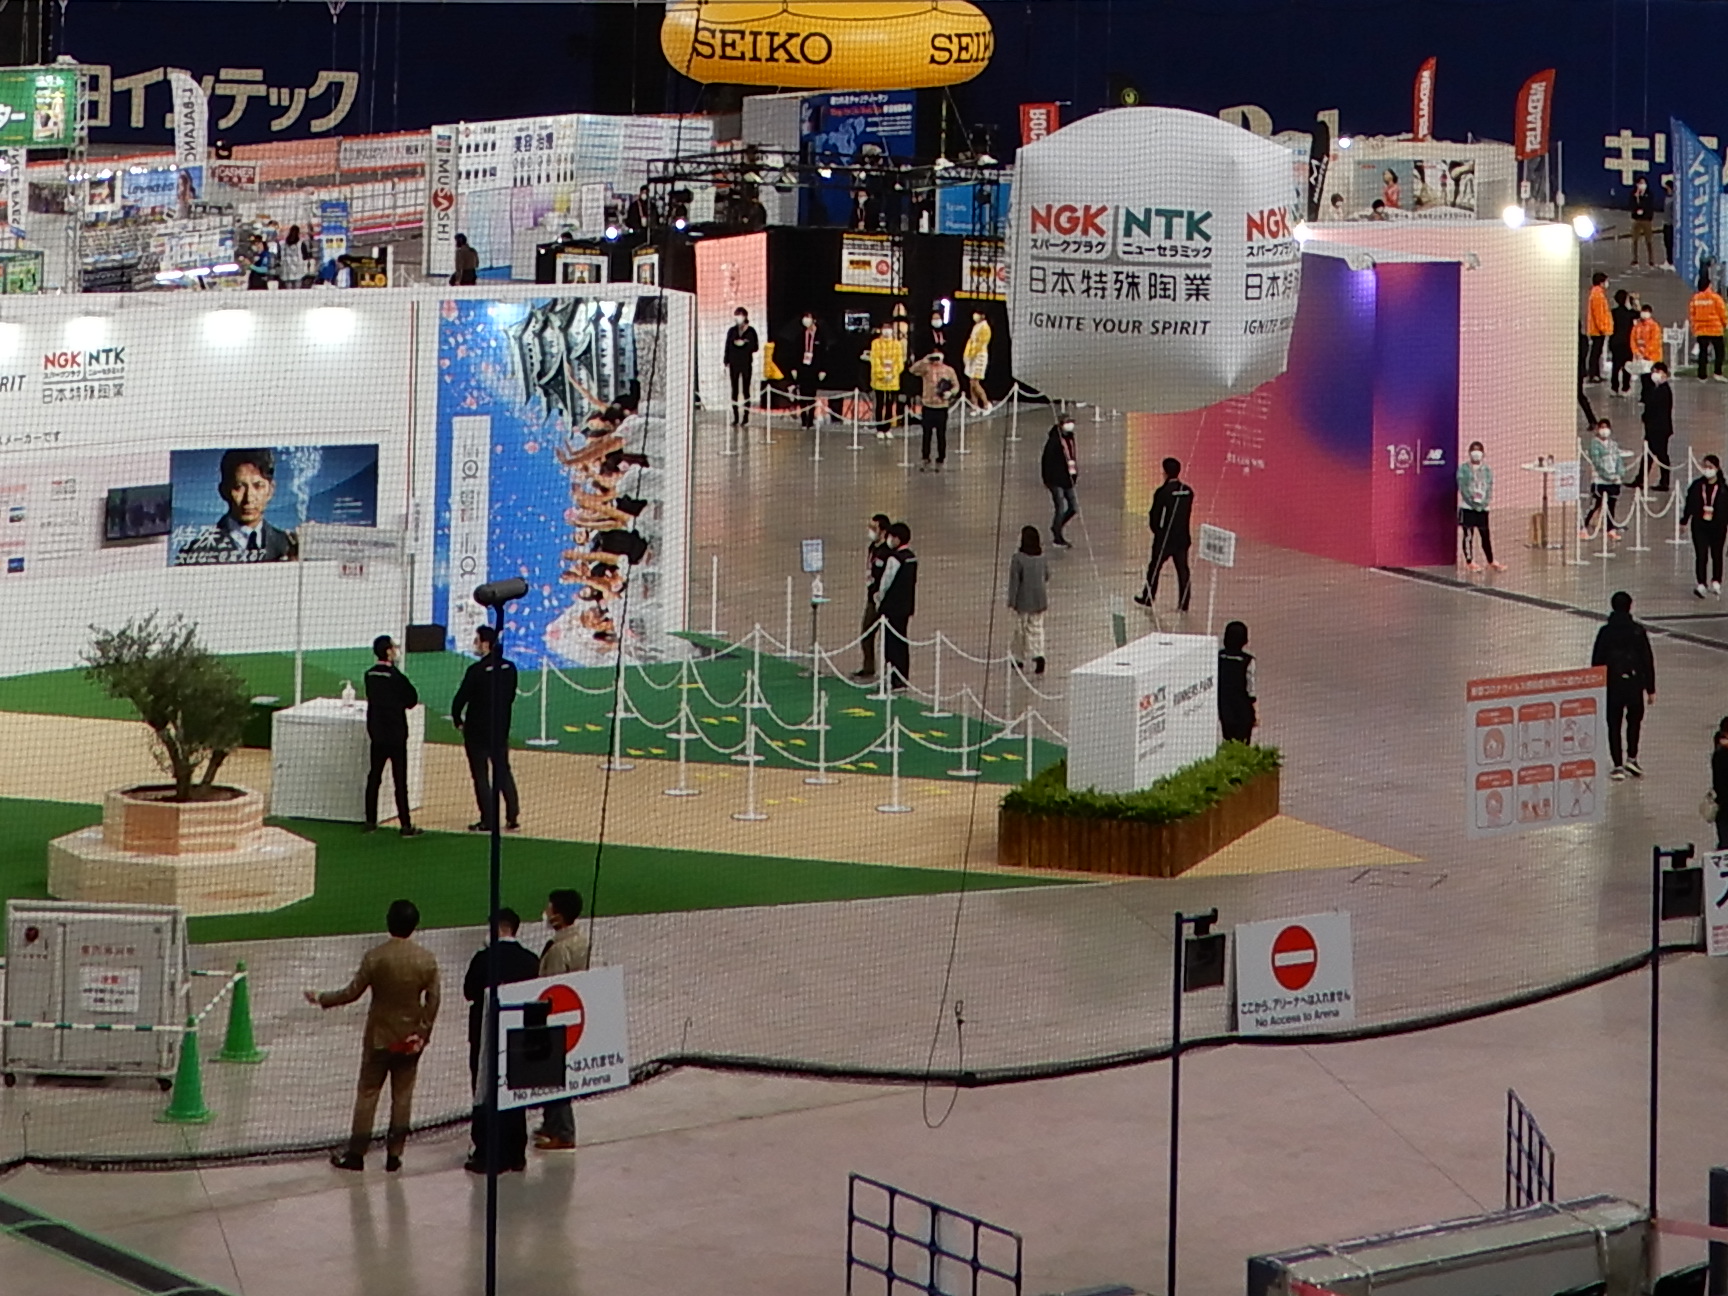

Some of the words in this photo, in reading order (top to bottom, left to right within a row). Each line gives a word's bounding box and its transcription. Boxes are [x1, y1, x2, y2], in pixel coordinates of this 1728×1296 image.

[693, 27, 833, 65] SEIKO
[433, 158, 455, 244] MUSASHI
[1030, 204, 1108, 238] NGK
[1123, 209, 1214, 242] NTK
[1030, 239, 1107, 256] スパークプラグ
[1122, 242, 1213, 260] ニューセラミック
[1029, 266, 1212, 303] 日本特殊陶業
[1028, 311, 1088, 333] IGNITE
[1092, 316, 1143, 336] YOUR
[1150, 318, 1212, 338] SPIRIT
[44, 351, 82, 370] NGK
[88, 346, 126, 366] NTK
[42, 383, 125, 405] 日本特殊陶業
[1255, 1017, 1268, 1028] No
[1270, 1014, 1301, 1026] Access
[1303, 1012, 1312, 1022] to
[1314, 1009, 1340, 1022] Arena
[569, 1079, 579, 1091] to
[581, 1073, 611, 1090] Arena
